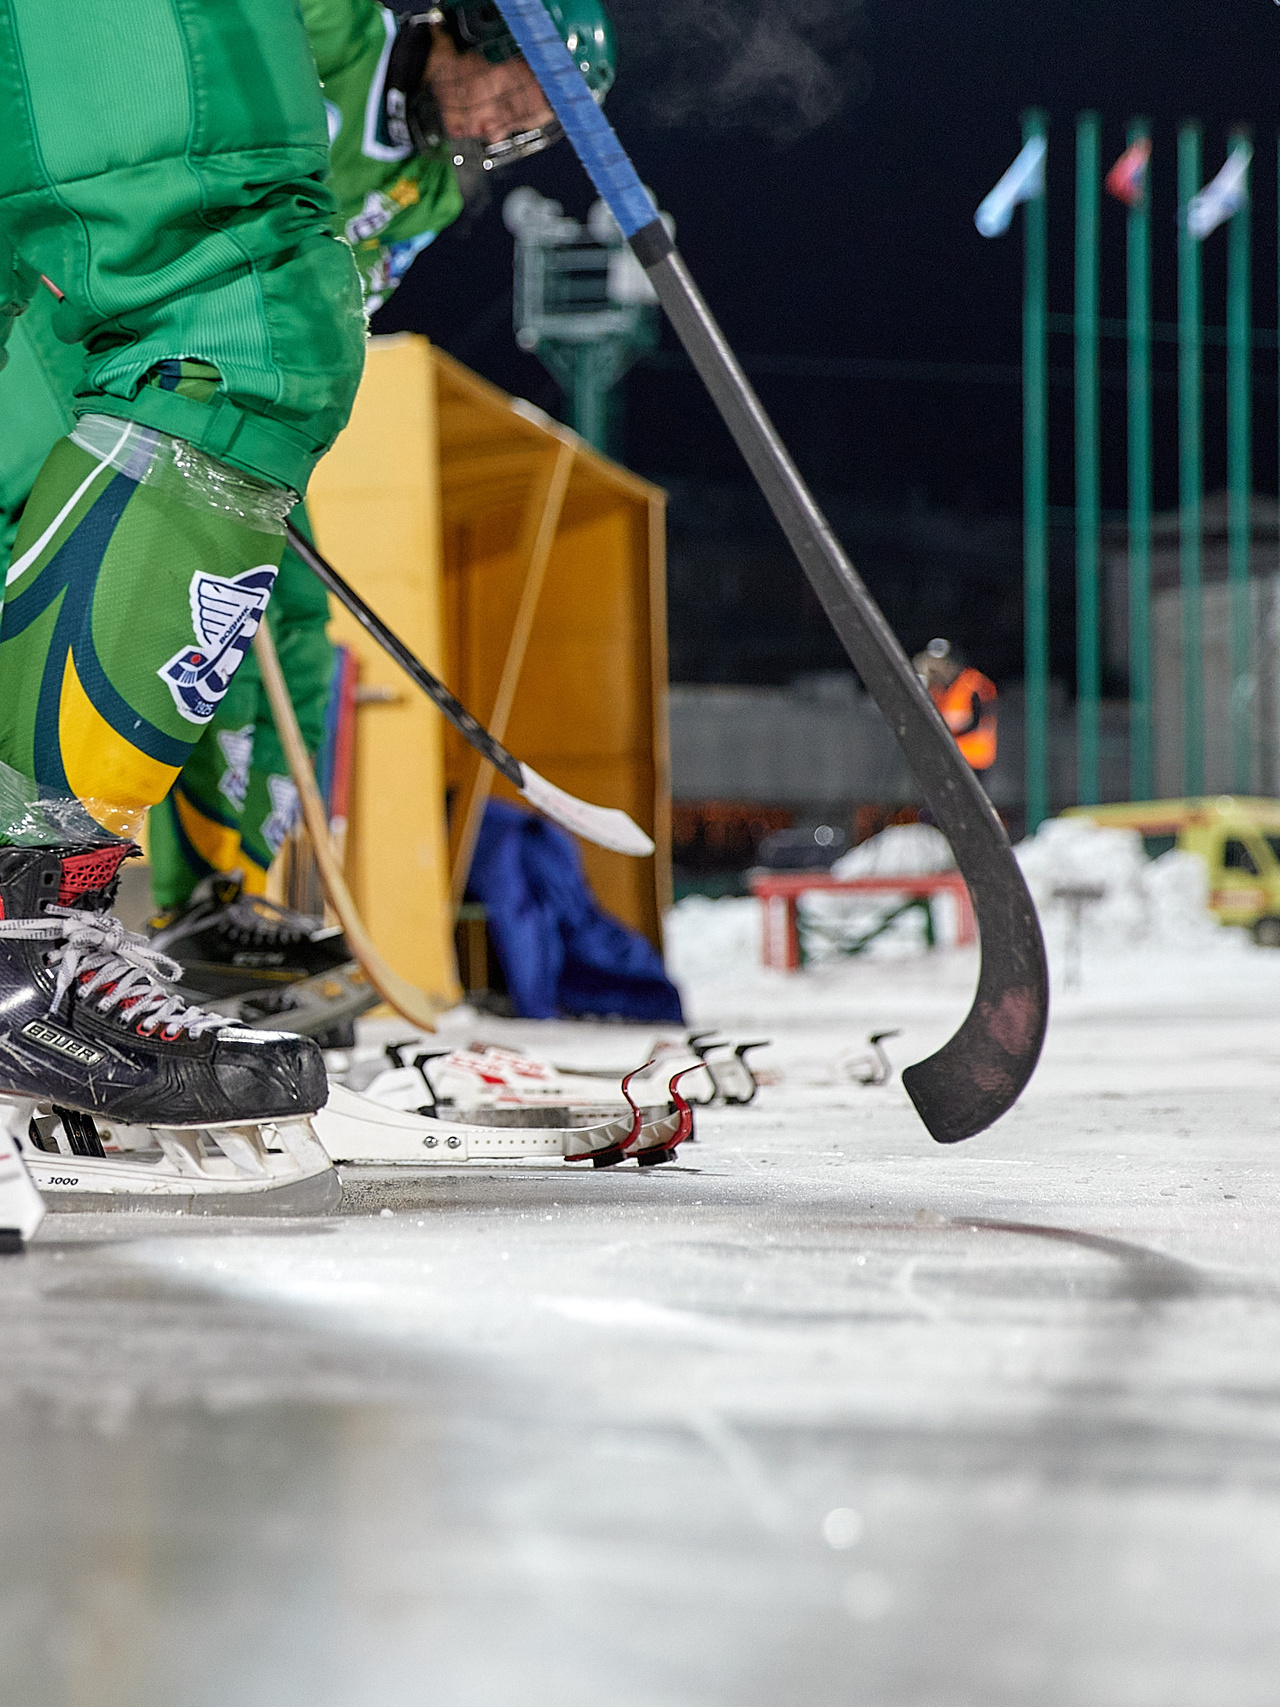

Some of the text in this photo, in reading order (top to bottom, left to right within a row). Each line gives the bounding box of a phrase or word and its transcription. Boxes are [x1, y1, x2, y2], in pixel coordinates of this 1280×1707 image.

[219, 605, 251, 645] ВОДНИК
[27, 1023, 97, 1061] BAUER
[47, 1176, 79, 1186] 3000
